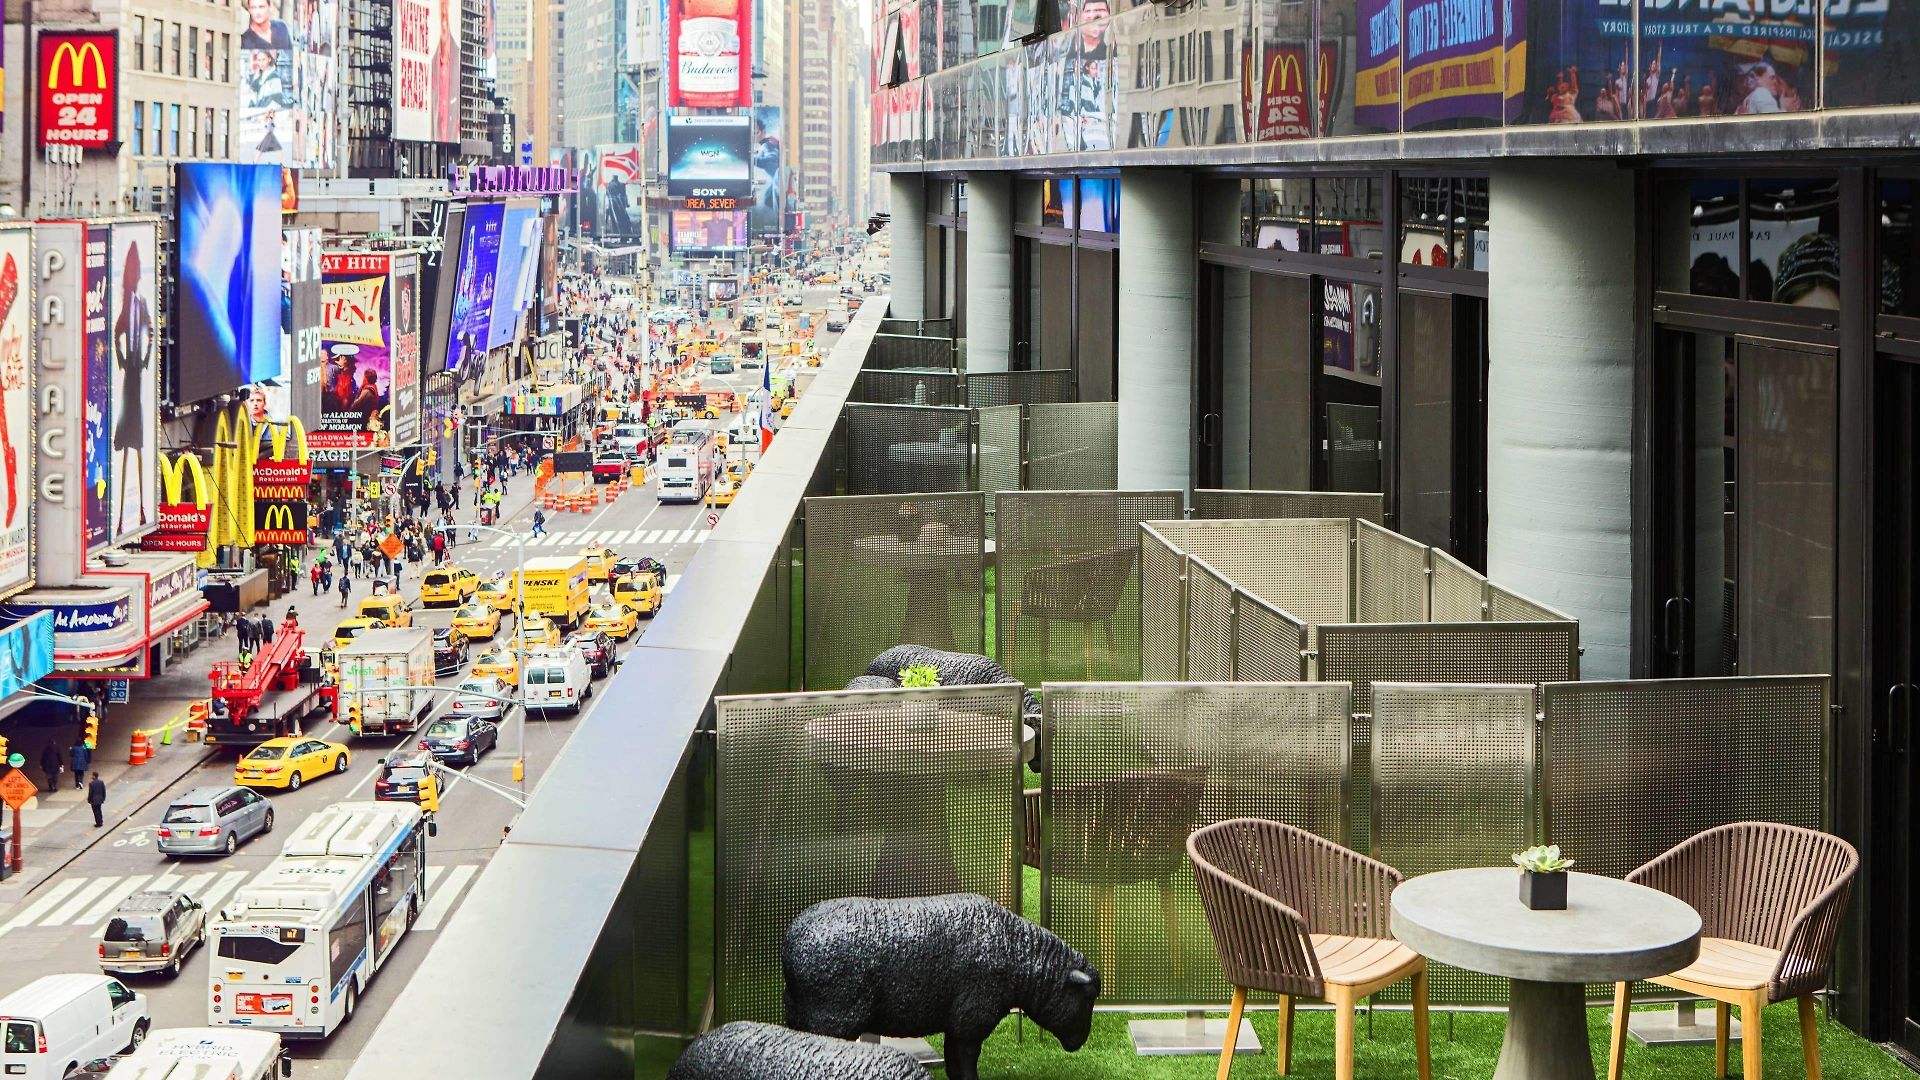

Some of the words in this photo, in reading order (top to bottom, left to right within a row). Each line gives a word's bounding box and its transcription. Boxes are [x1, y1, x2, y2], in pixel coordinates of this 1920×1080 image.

[399, 0, 430, 54] WAYNE
[682, 61, 738, 75] Budweiser
[400, 58, 430, 111] BRADY
[52, 92, 103, 105] OPEN
[58, 106, 97, 126] 24
[46, 129, 109, 141] HOURS
[692, 188, 727, 197] SONY
[321, 256, 342, 270] AT
[321, 285, 379, 329] TEN!
[41, 250, 66, 502] PALACE
[253, 467, 308, 476] McDonald's
